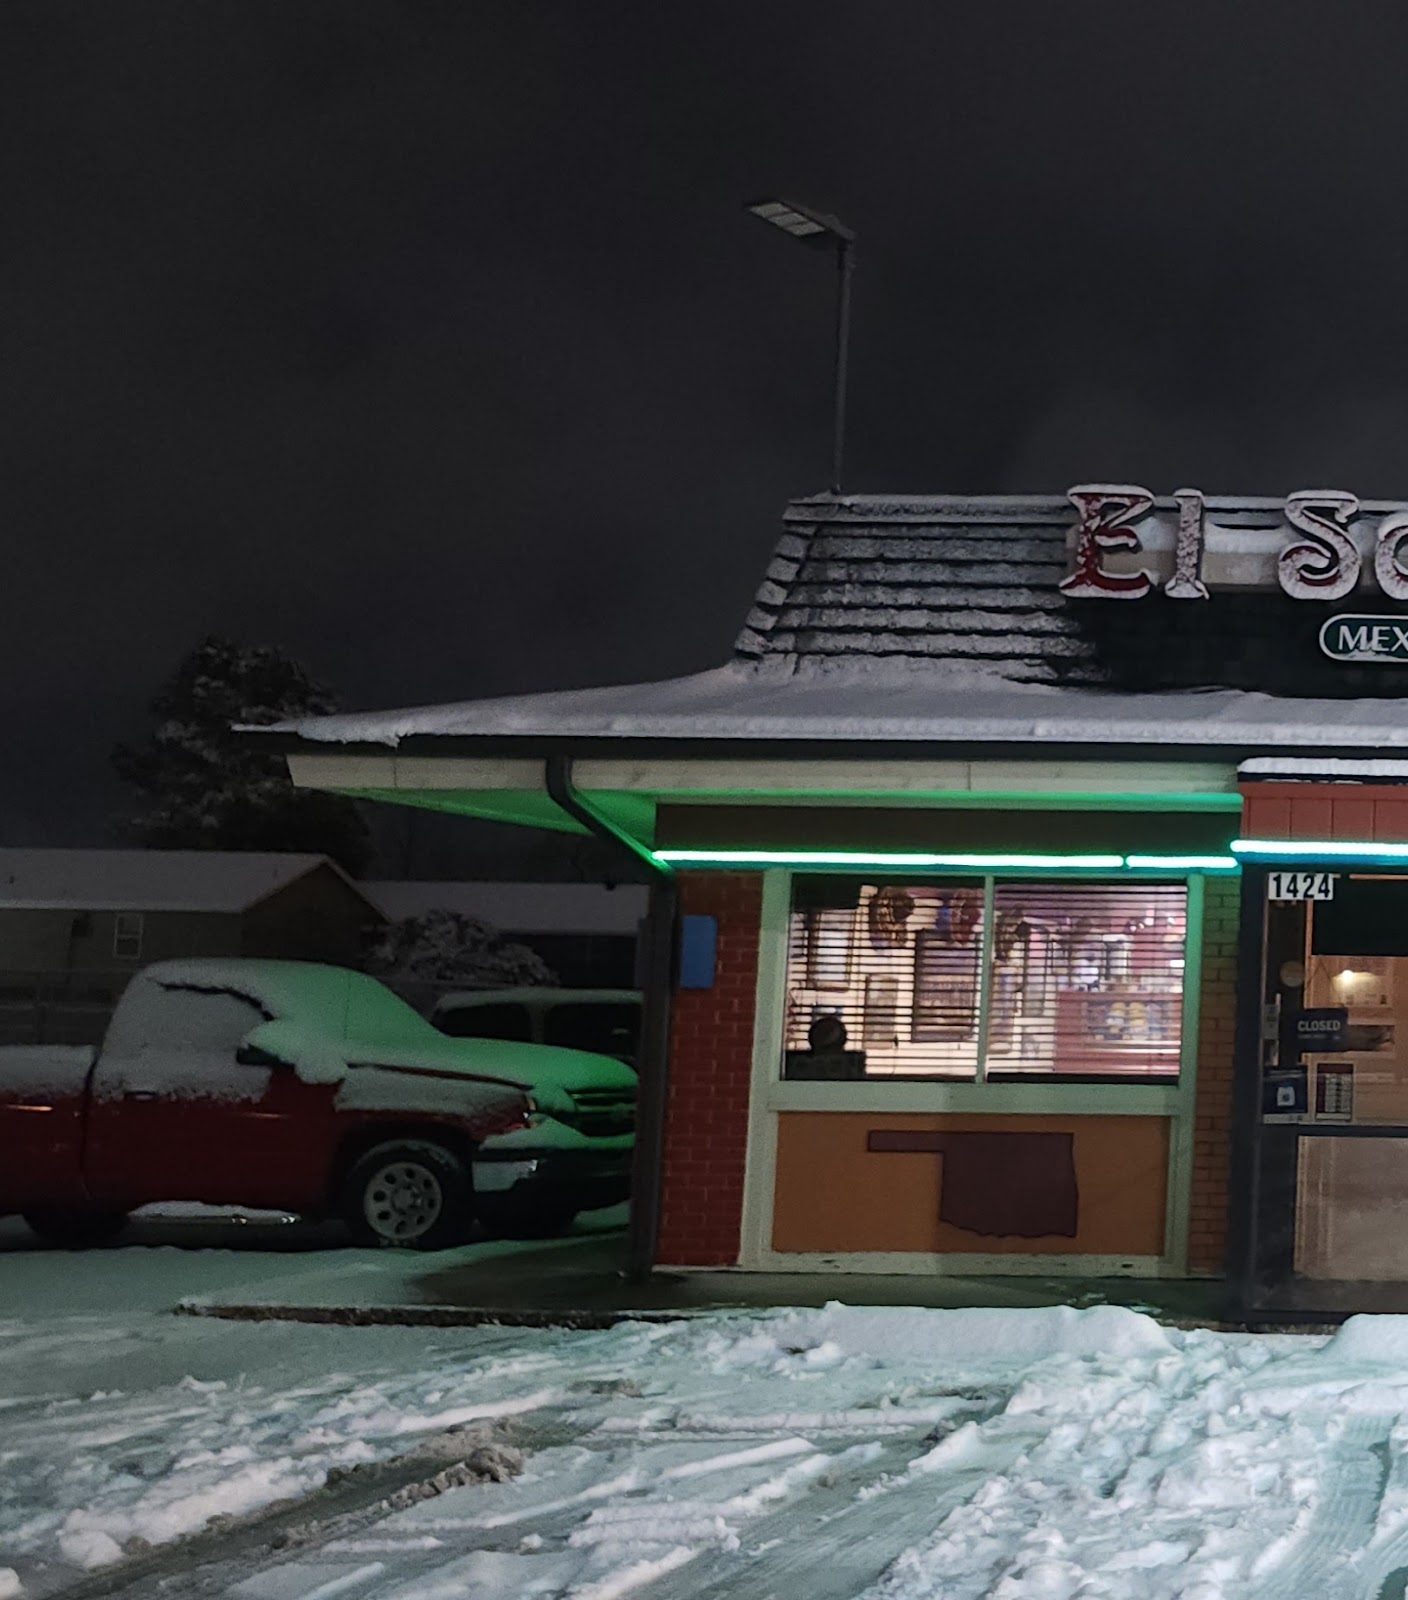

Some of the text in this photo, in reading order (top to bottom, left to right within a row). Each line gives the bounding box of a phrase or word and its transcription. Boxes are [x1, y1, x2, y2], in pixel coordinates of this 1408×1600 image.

[1059, 483, 1210, 600] El
[1272, 872, 1331, 899] 1424
[1297, 1019, 1342, 1032] CLOSED
